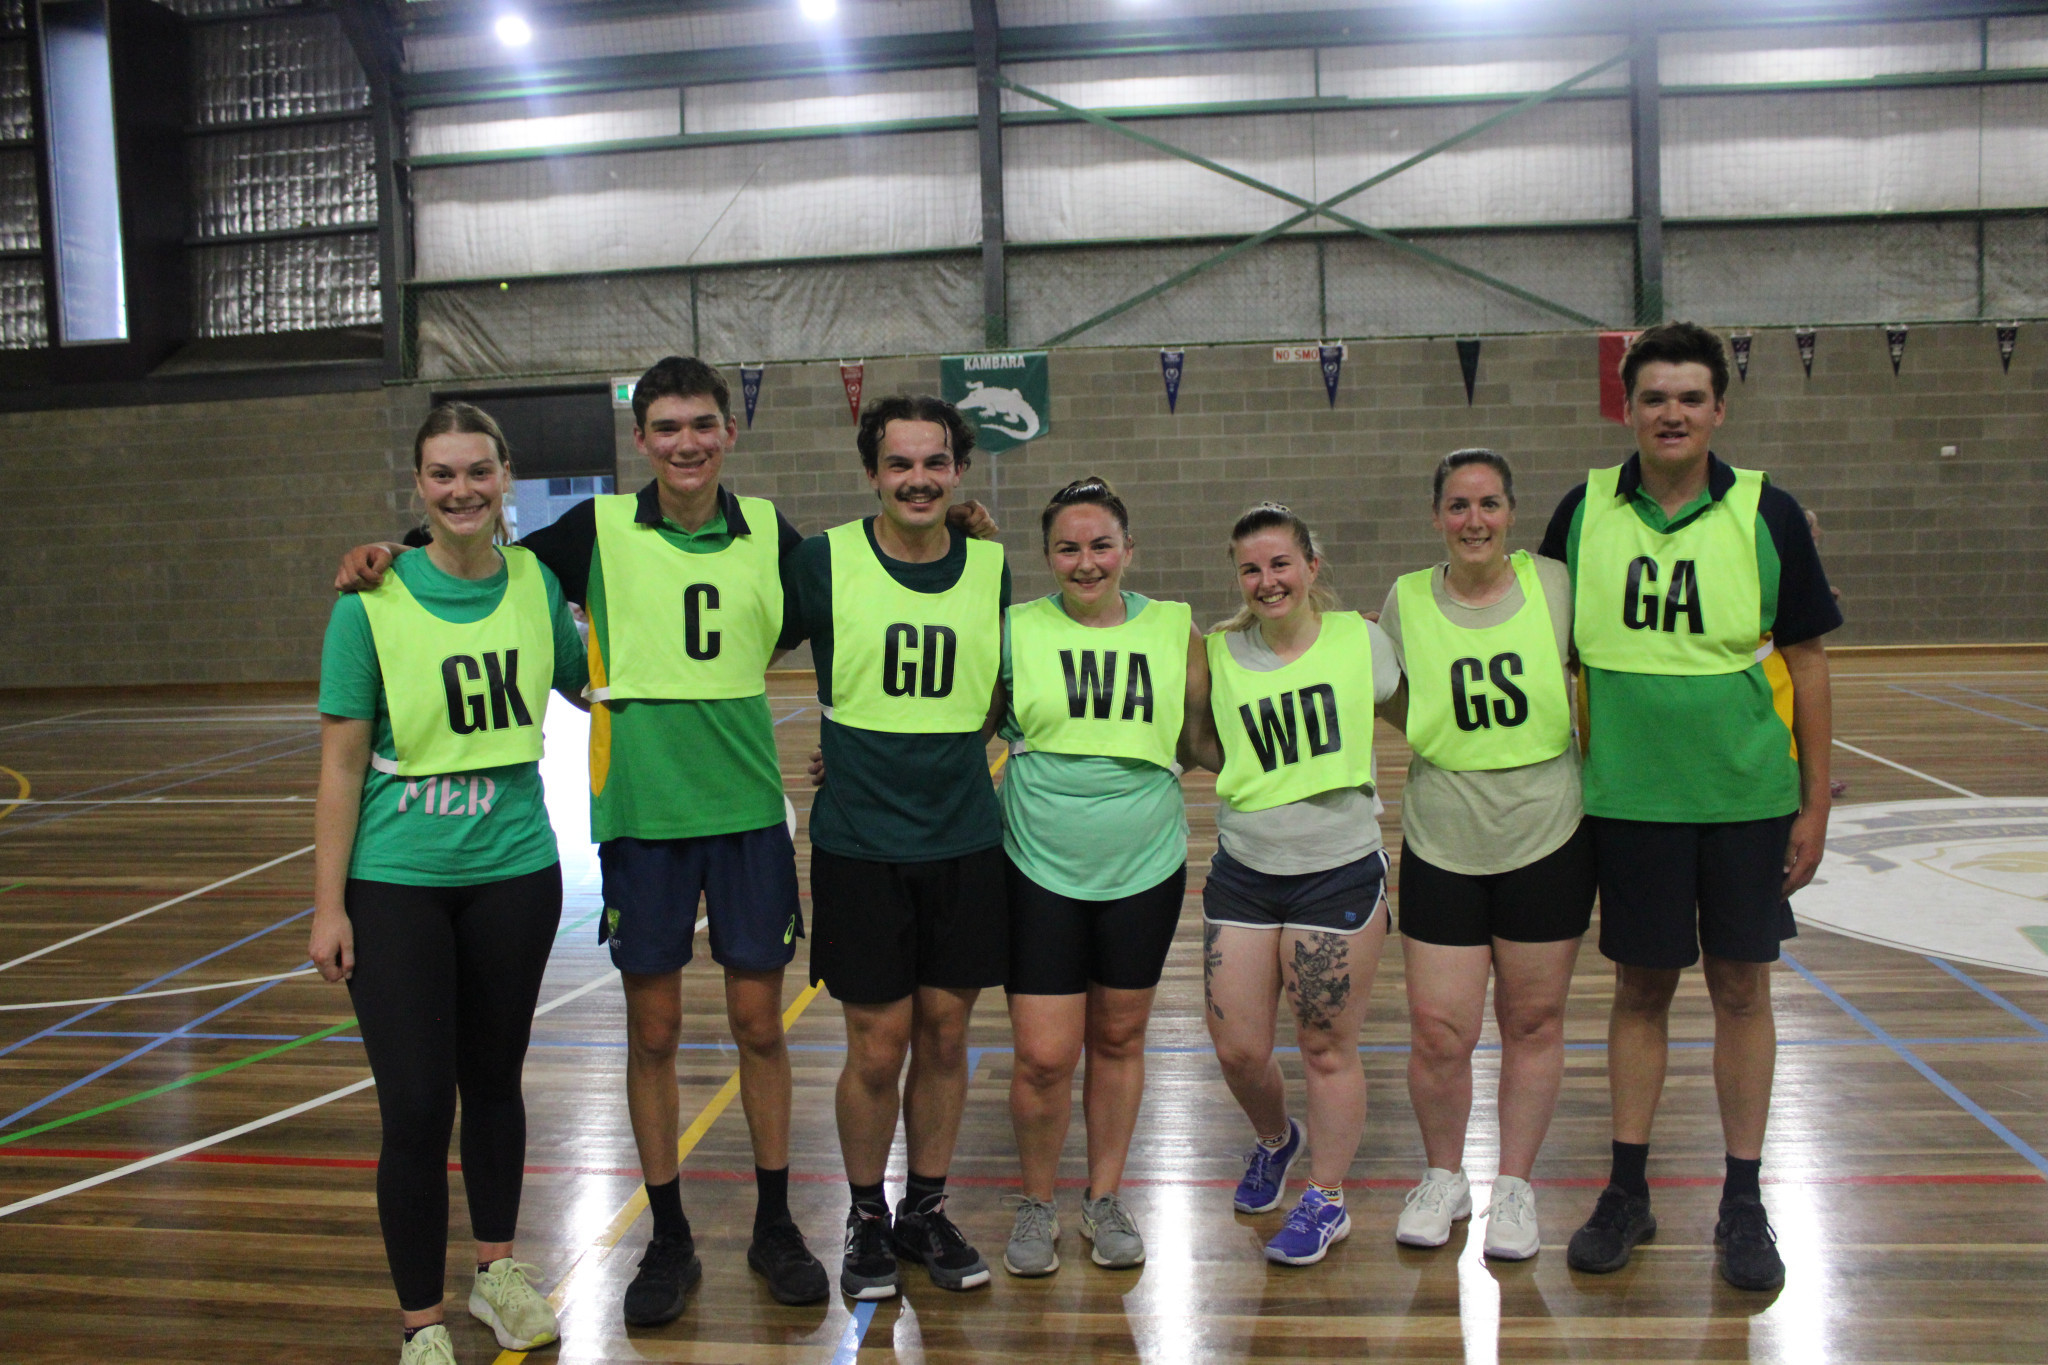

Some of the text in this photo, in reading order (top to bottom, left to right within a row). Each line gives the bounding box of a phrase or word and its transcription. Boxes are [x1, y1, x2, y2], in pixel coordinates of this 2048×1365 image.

[963, 354, 1026, 371] KAMBARA
[1275, 349, 1290, 361] NO
[683, 583, 721, 661] C
[1623, 555, 1705, 634] GA
[441, 649, 533, 735] GK
[882, 622, 957, 699] GD
[1059, 650, 1154, 724] WA
[1450, 652, 1528, 732] GS
[1238, 683, 1341, 773] WD
[398, 775, 496, 816] MER
